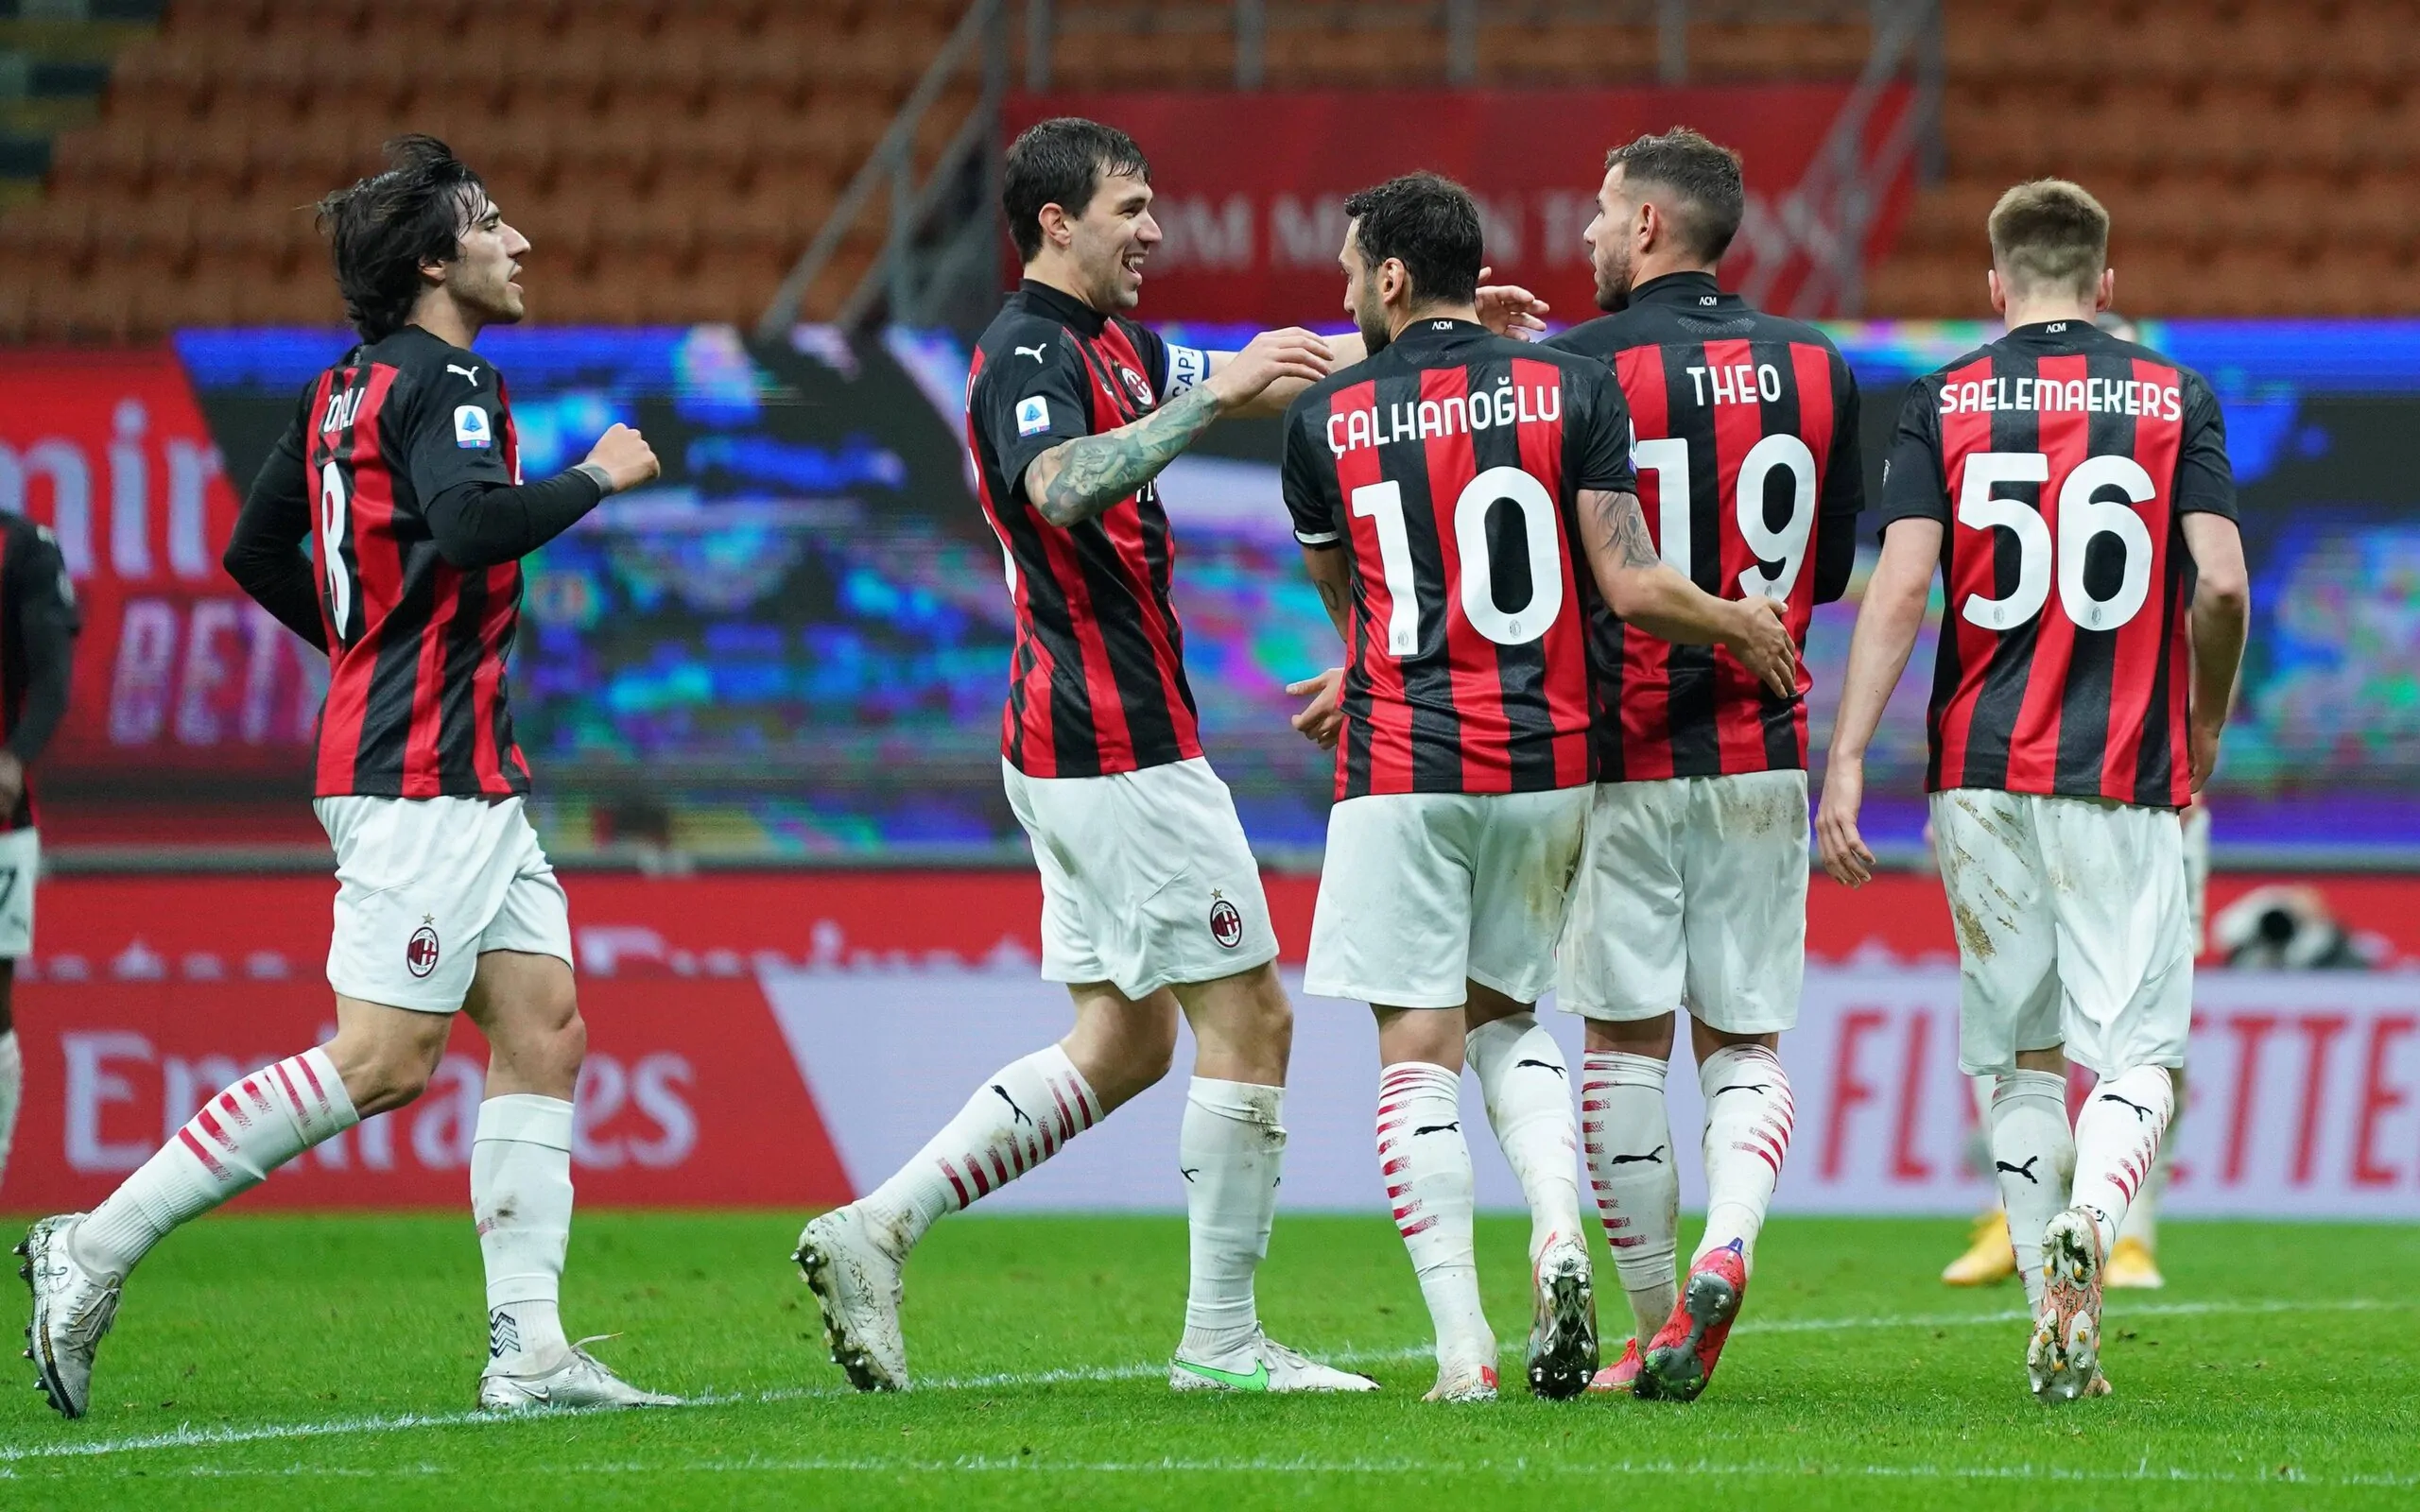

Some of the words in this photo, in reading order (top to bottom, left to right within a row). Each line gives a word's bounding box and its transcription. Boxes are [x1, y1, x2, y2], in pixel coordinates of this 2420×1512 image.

[1326, 377, 1561, 461] ÇALHANOĞLU
[1686, 364, 1782, 406] THEO
[1939, 377, 2182, 422] SAELEMAEKERS
[321, 460, 351, 641] 8
[1351, 466, 1564, 656] 10
[1636, 434, 1817, 598] 19
[1957, 452, 2156, 632] 56
